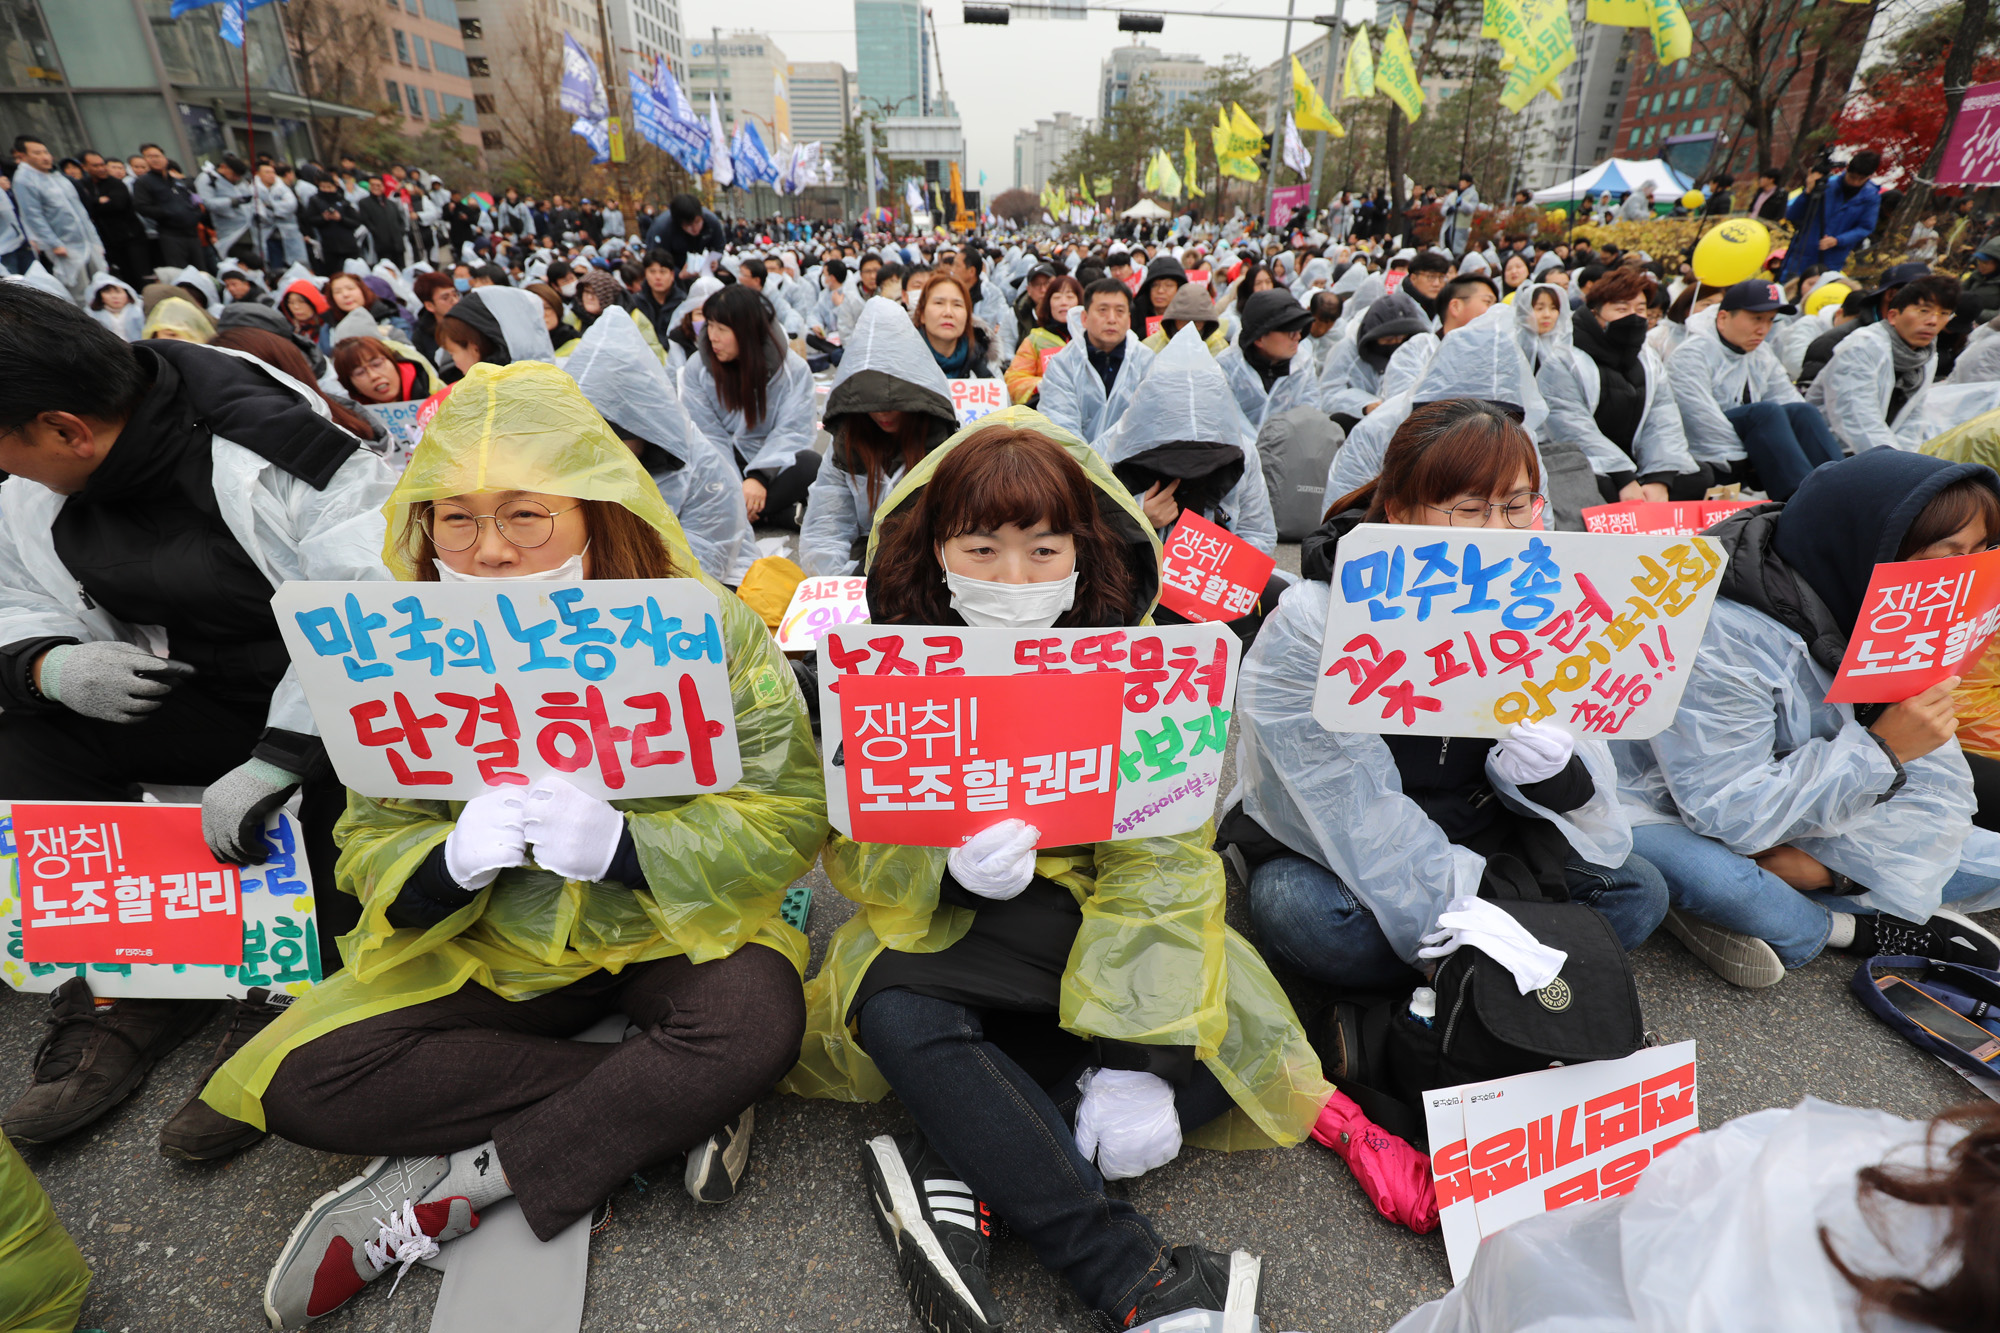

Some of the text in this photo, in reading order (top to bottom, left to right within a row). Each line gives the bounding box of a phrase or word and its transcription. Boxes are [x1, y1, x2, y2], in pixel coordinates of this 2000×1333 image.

[950, 381, 1001, 410] 우리는
[1172, 525, 1233, 573] 쟁취!
[1223, 583, 1260, 615] 권리
[1341, 537, 1562, 630] 민주노총
[1870, 570, 1976, 634] 쟁취!
[295, 587, 723, 682] 만국의 노동자여
[1570, 624, 1676, 735] 출동!!
[348, 673, 726, 789] 단결하라
[854, 697, 978, 761] 쟁취!
[1020, 744, 1114, 806] 권리
[1113, 771, 1218, 834] 한국와이퍼분회
[24, 822, 125, 879] 쟁취!
[160, 869, 237, 920] 권리
[126, 948, 153, 957] 민주노총
[1470, 1061, 1695, 1204] 전면개정
